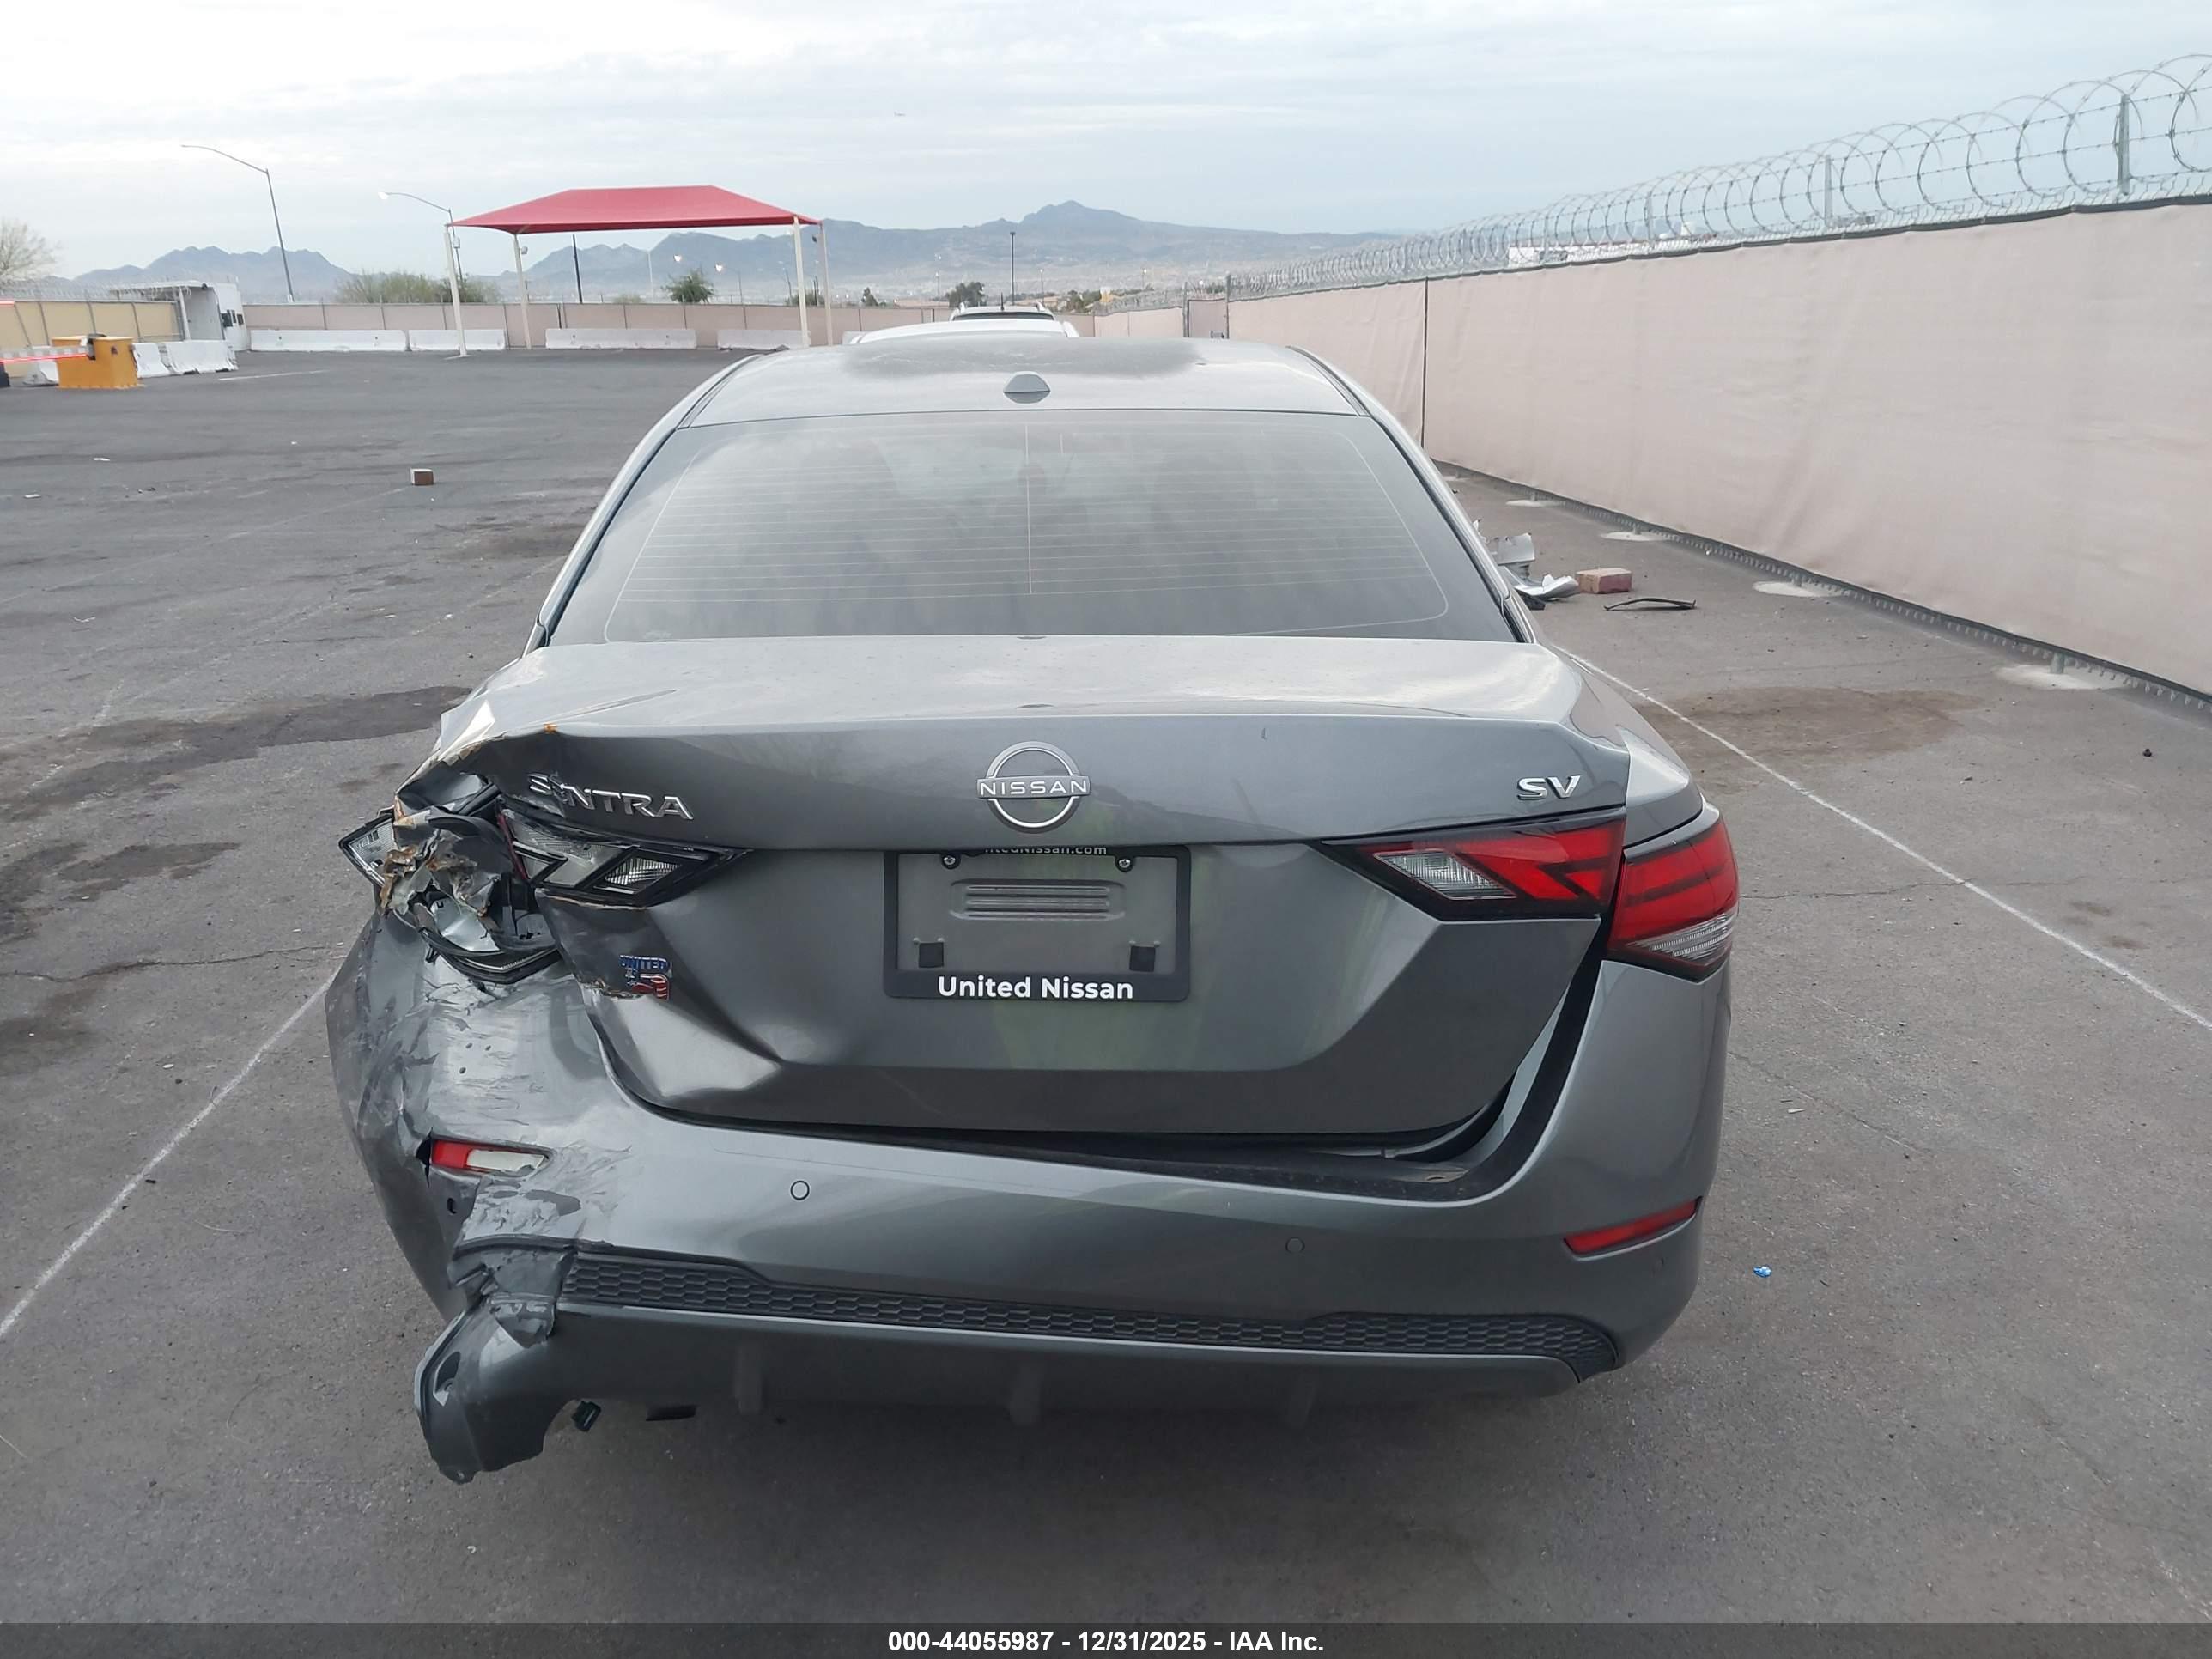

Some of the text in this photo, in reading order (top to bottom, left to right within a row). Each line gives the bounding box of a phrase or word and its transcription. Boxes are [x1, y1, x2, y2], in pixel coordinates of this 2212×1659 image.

[981, 780, 1087, 795] NISSAN
[1516, 775, 1581, 800] SV
[938, 975, 1133, 1000] United Nissan
